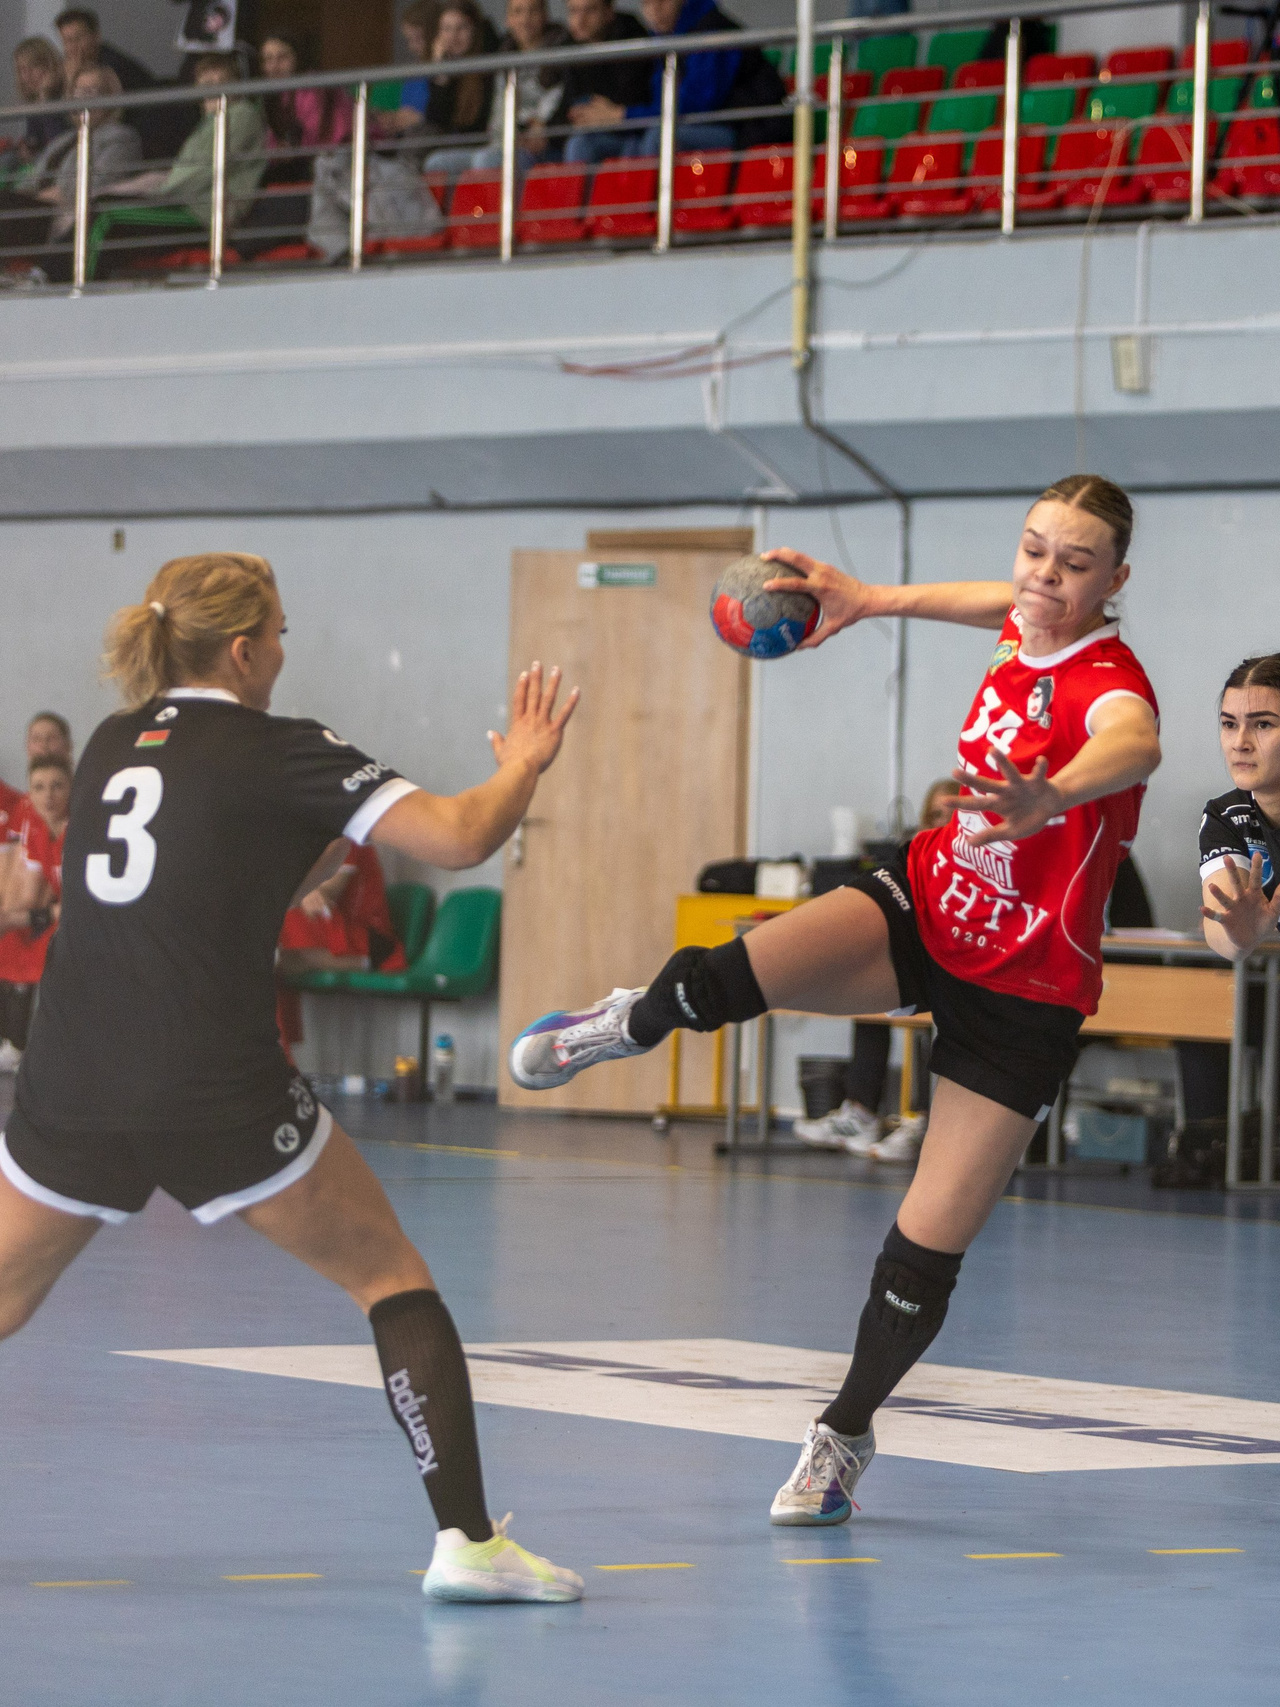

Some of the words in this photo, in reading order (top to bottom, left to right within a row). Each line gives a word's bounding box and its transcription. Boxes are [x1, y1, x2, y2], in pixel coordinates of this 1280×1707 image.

[960, 686, 1024, 756] 34
[85, 765, 164, 905] 3
[872, 868, 910, 910] Kempa
[932, 850, 1048, 942] НТУ
[885, 1289, 921, 1312] SELECT
